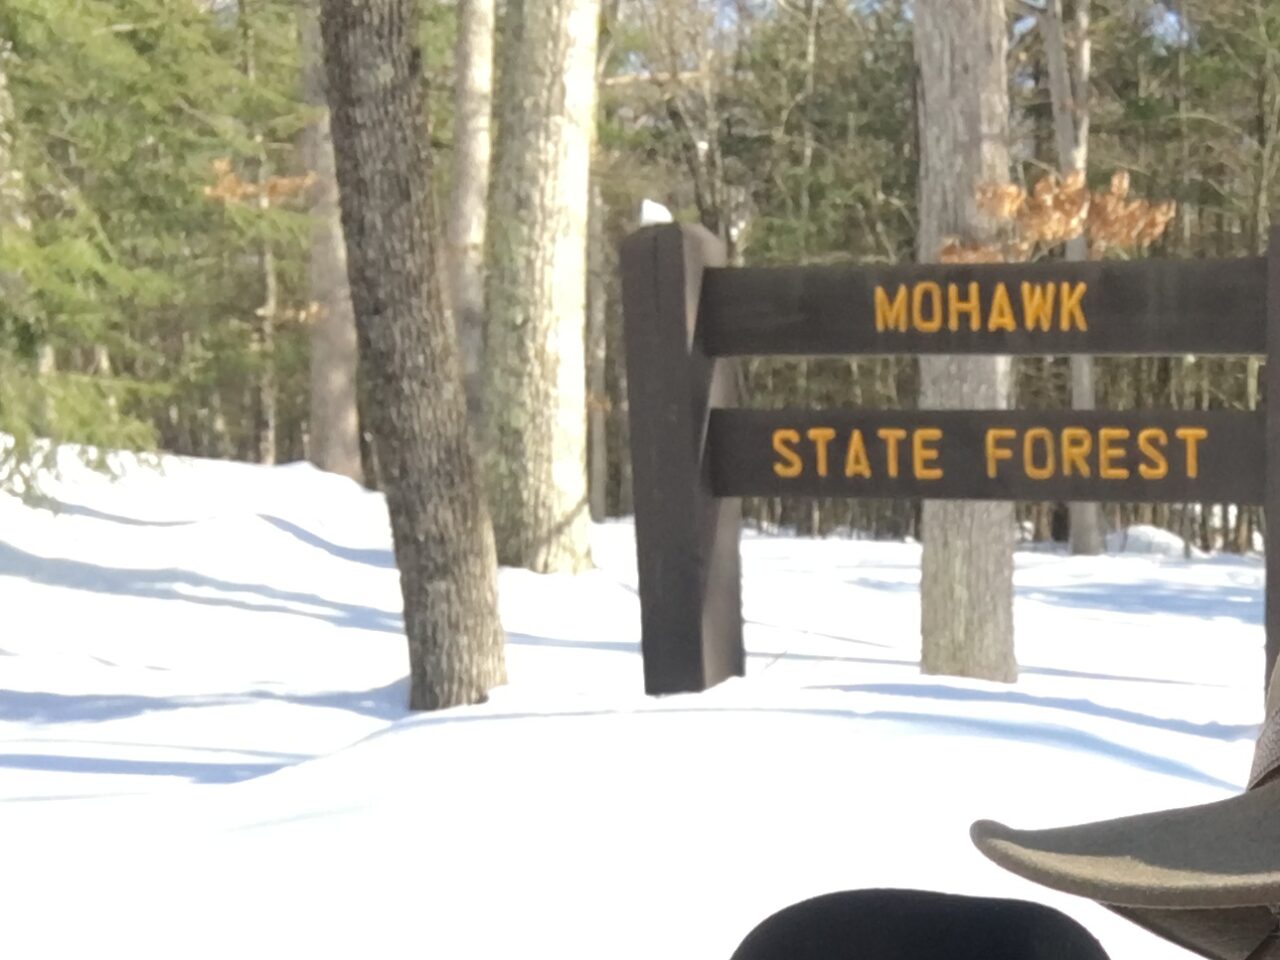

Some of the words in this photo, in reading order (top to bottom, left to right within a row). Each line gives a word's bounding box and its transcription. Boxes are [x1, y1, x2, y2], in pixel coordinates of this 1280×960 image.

[873, 281, 1087, 333] MOHAWK
[772, 427, 944, 479] STATE
[985, 427, 1208, 480] FOREST
